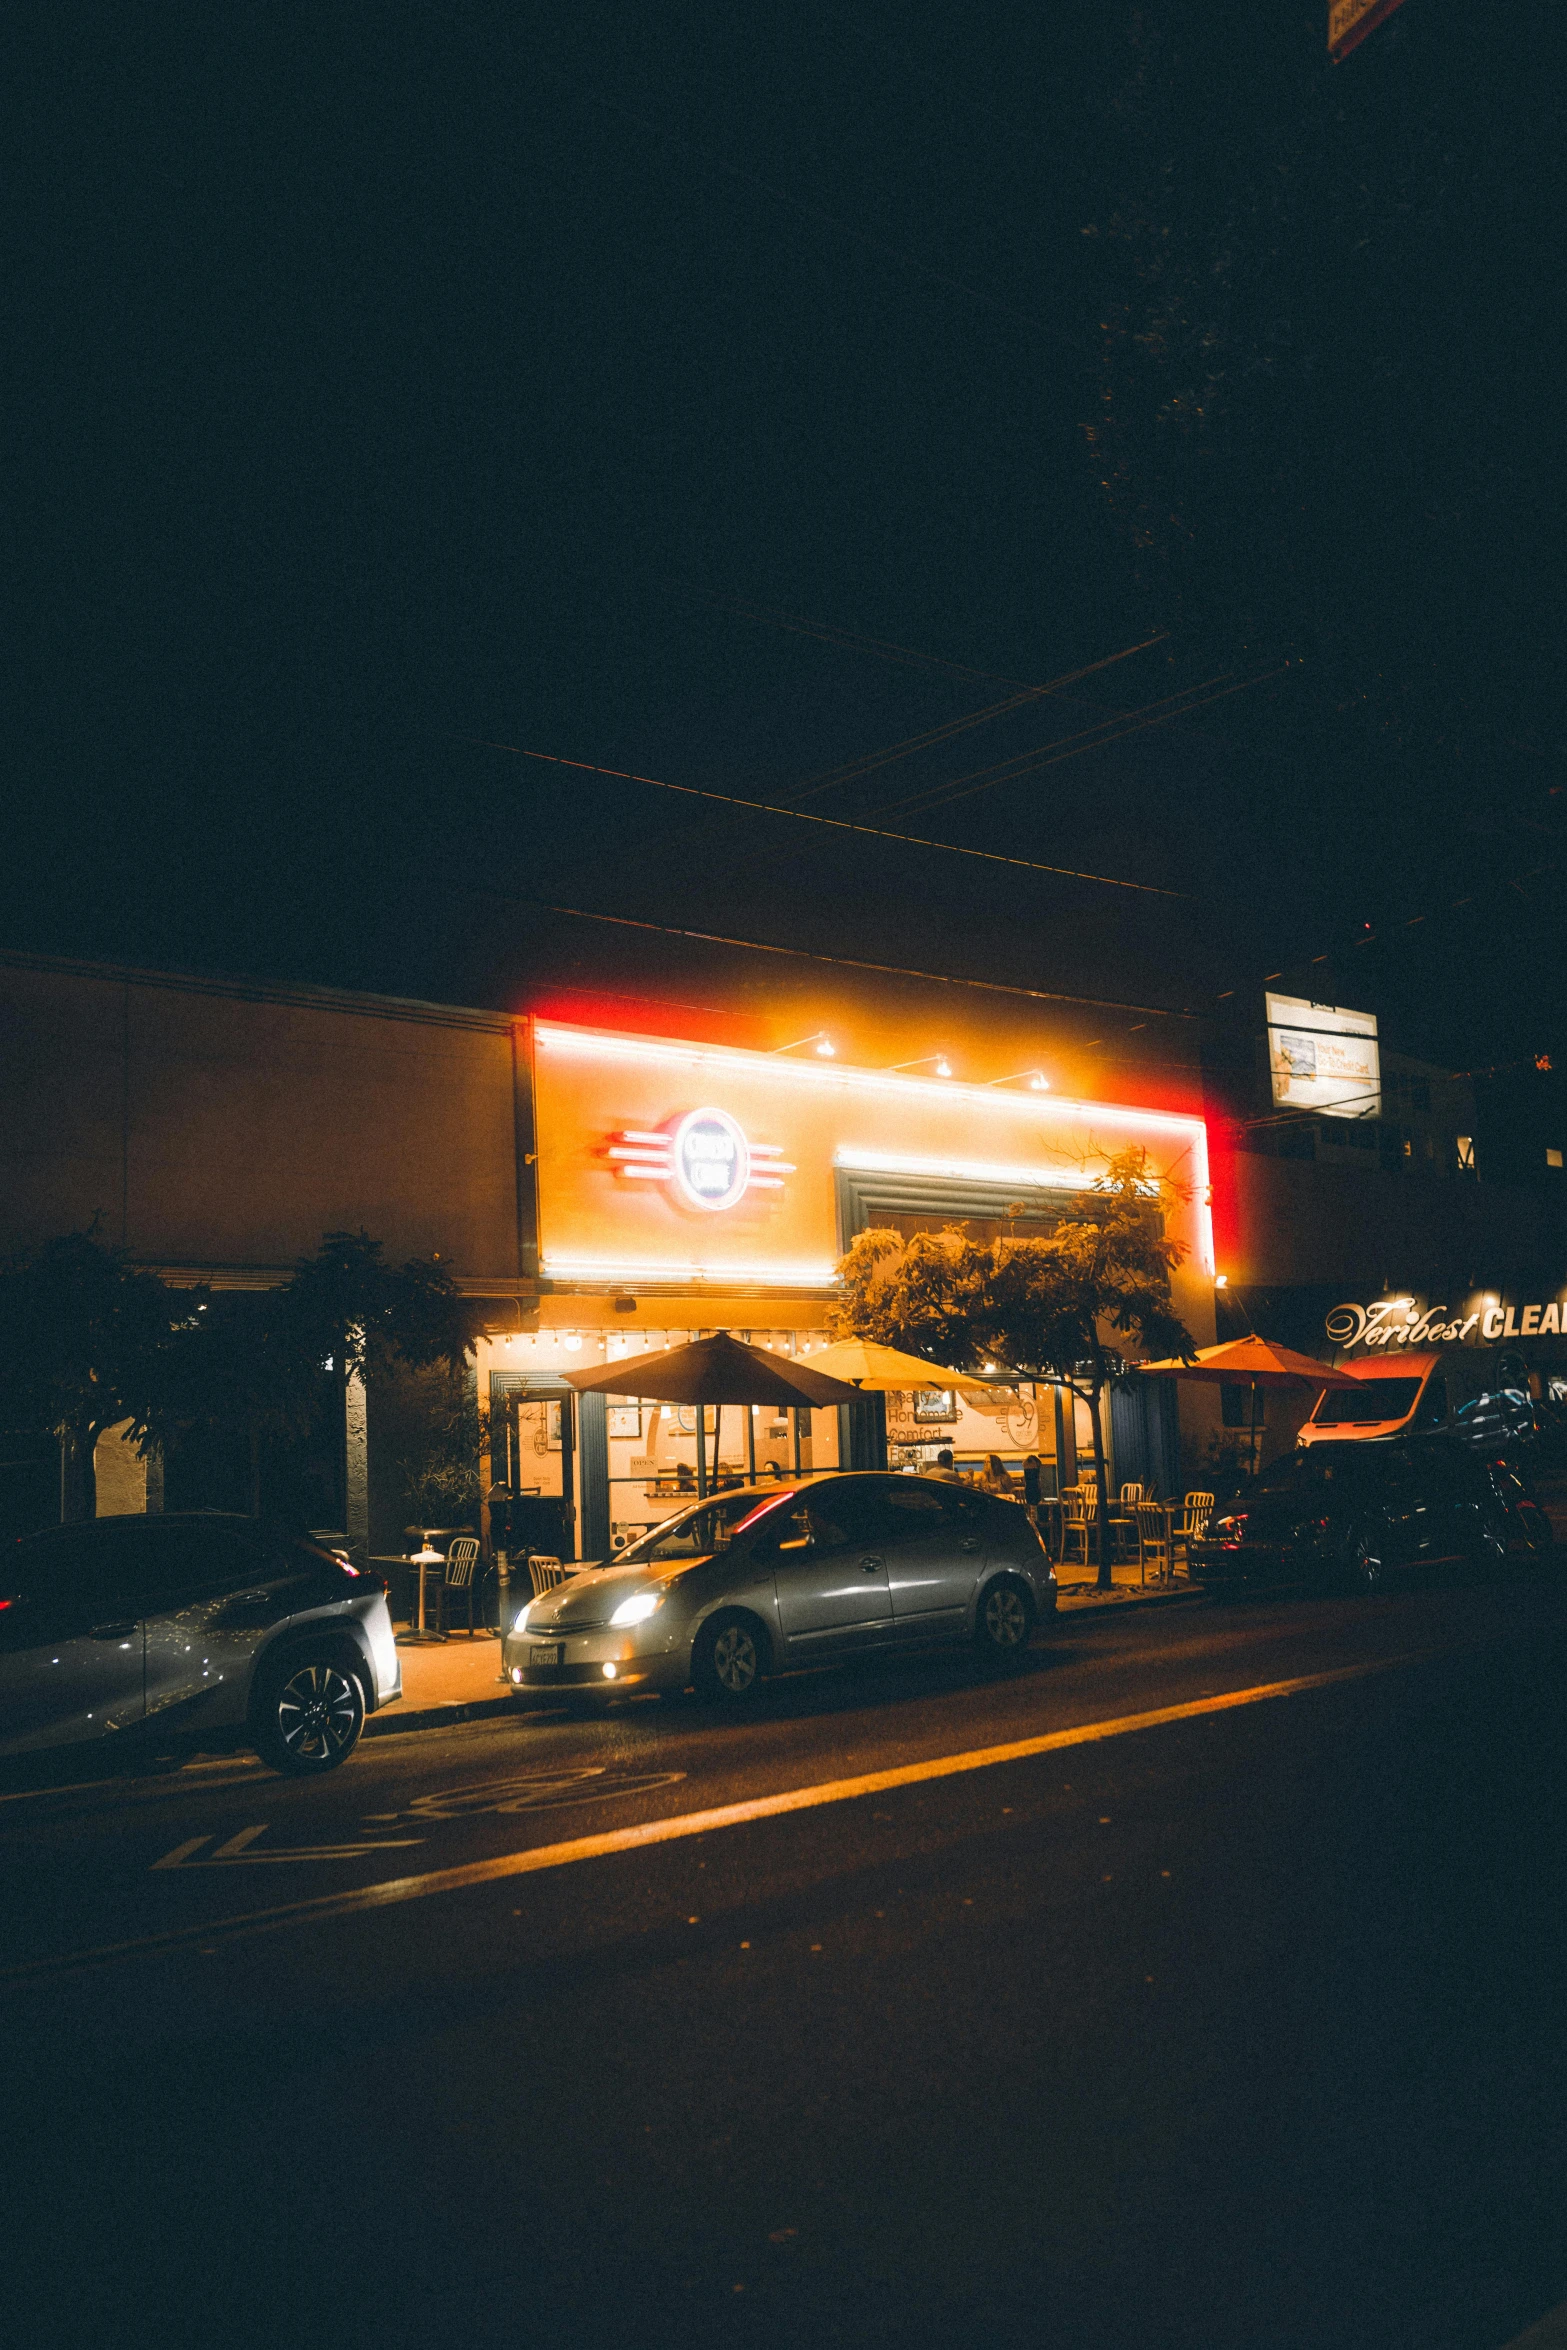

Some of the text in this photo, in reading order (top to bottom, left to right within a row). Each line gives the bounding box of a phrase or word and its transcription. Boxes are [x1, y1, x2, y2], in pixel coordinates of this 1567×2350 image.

[1326, 1298, 1480, 1349] Veribest
[888, 1409, 963, 1423] Homemade
[889, 1427, 942, 1442] Comfort
[890, 1447, 923, 1460] Food
